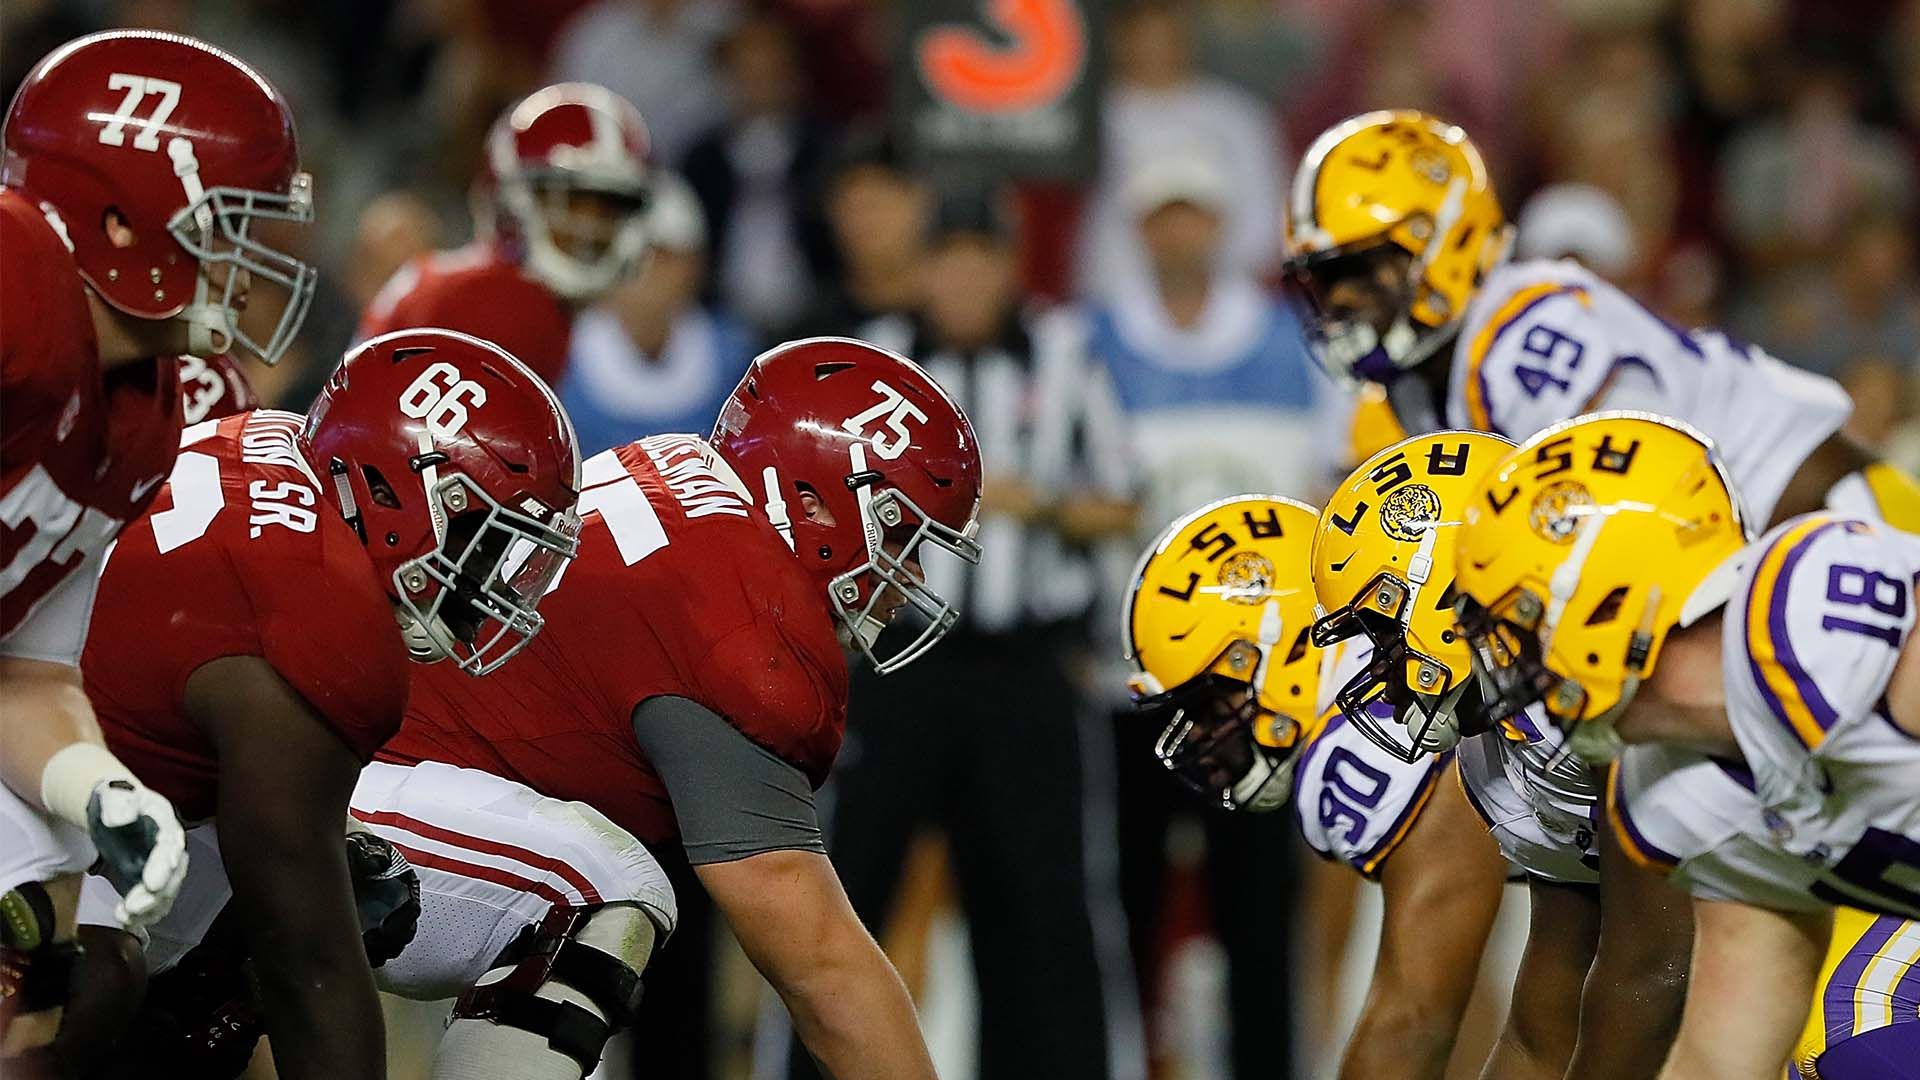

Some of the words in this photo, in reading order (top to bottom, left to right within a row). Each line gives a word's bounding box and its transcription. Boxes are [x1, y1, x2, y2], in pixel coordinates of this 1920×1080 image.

[99, 73, 181, 152] 77
[400, 362, 486, 437] 66
[1514, 325, 1584, 397] 49
[842, 380, 928, 461] 75
[249, 479, 318, 539] SR.
[519, 497, 548, 519] NIKE
[1822, 564, 1906, 648] 18
[1319, 745, 1391, 846] 90
